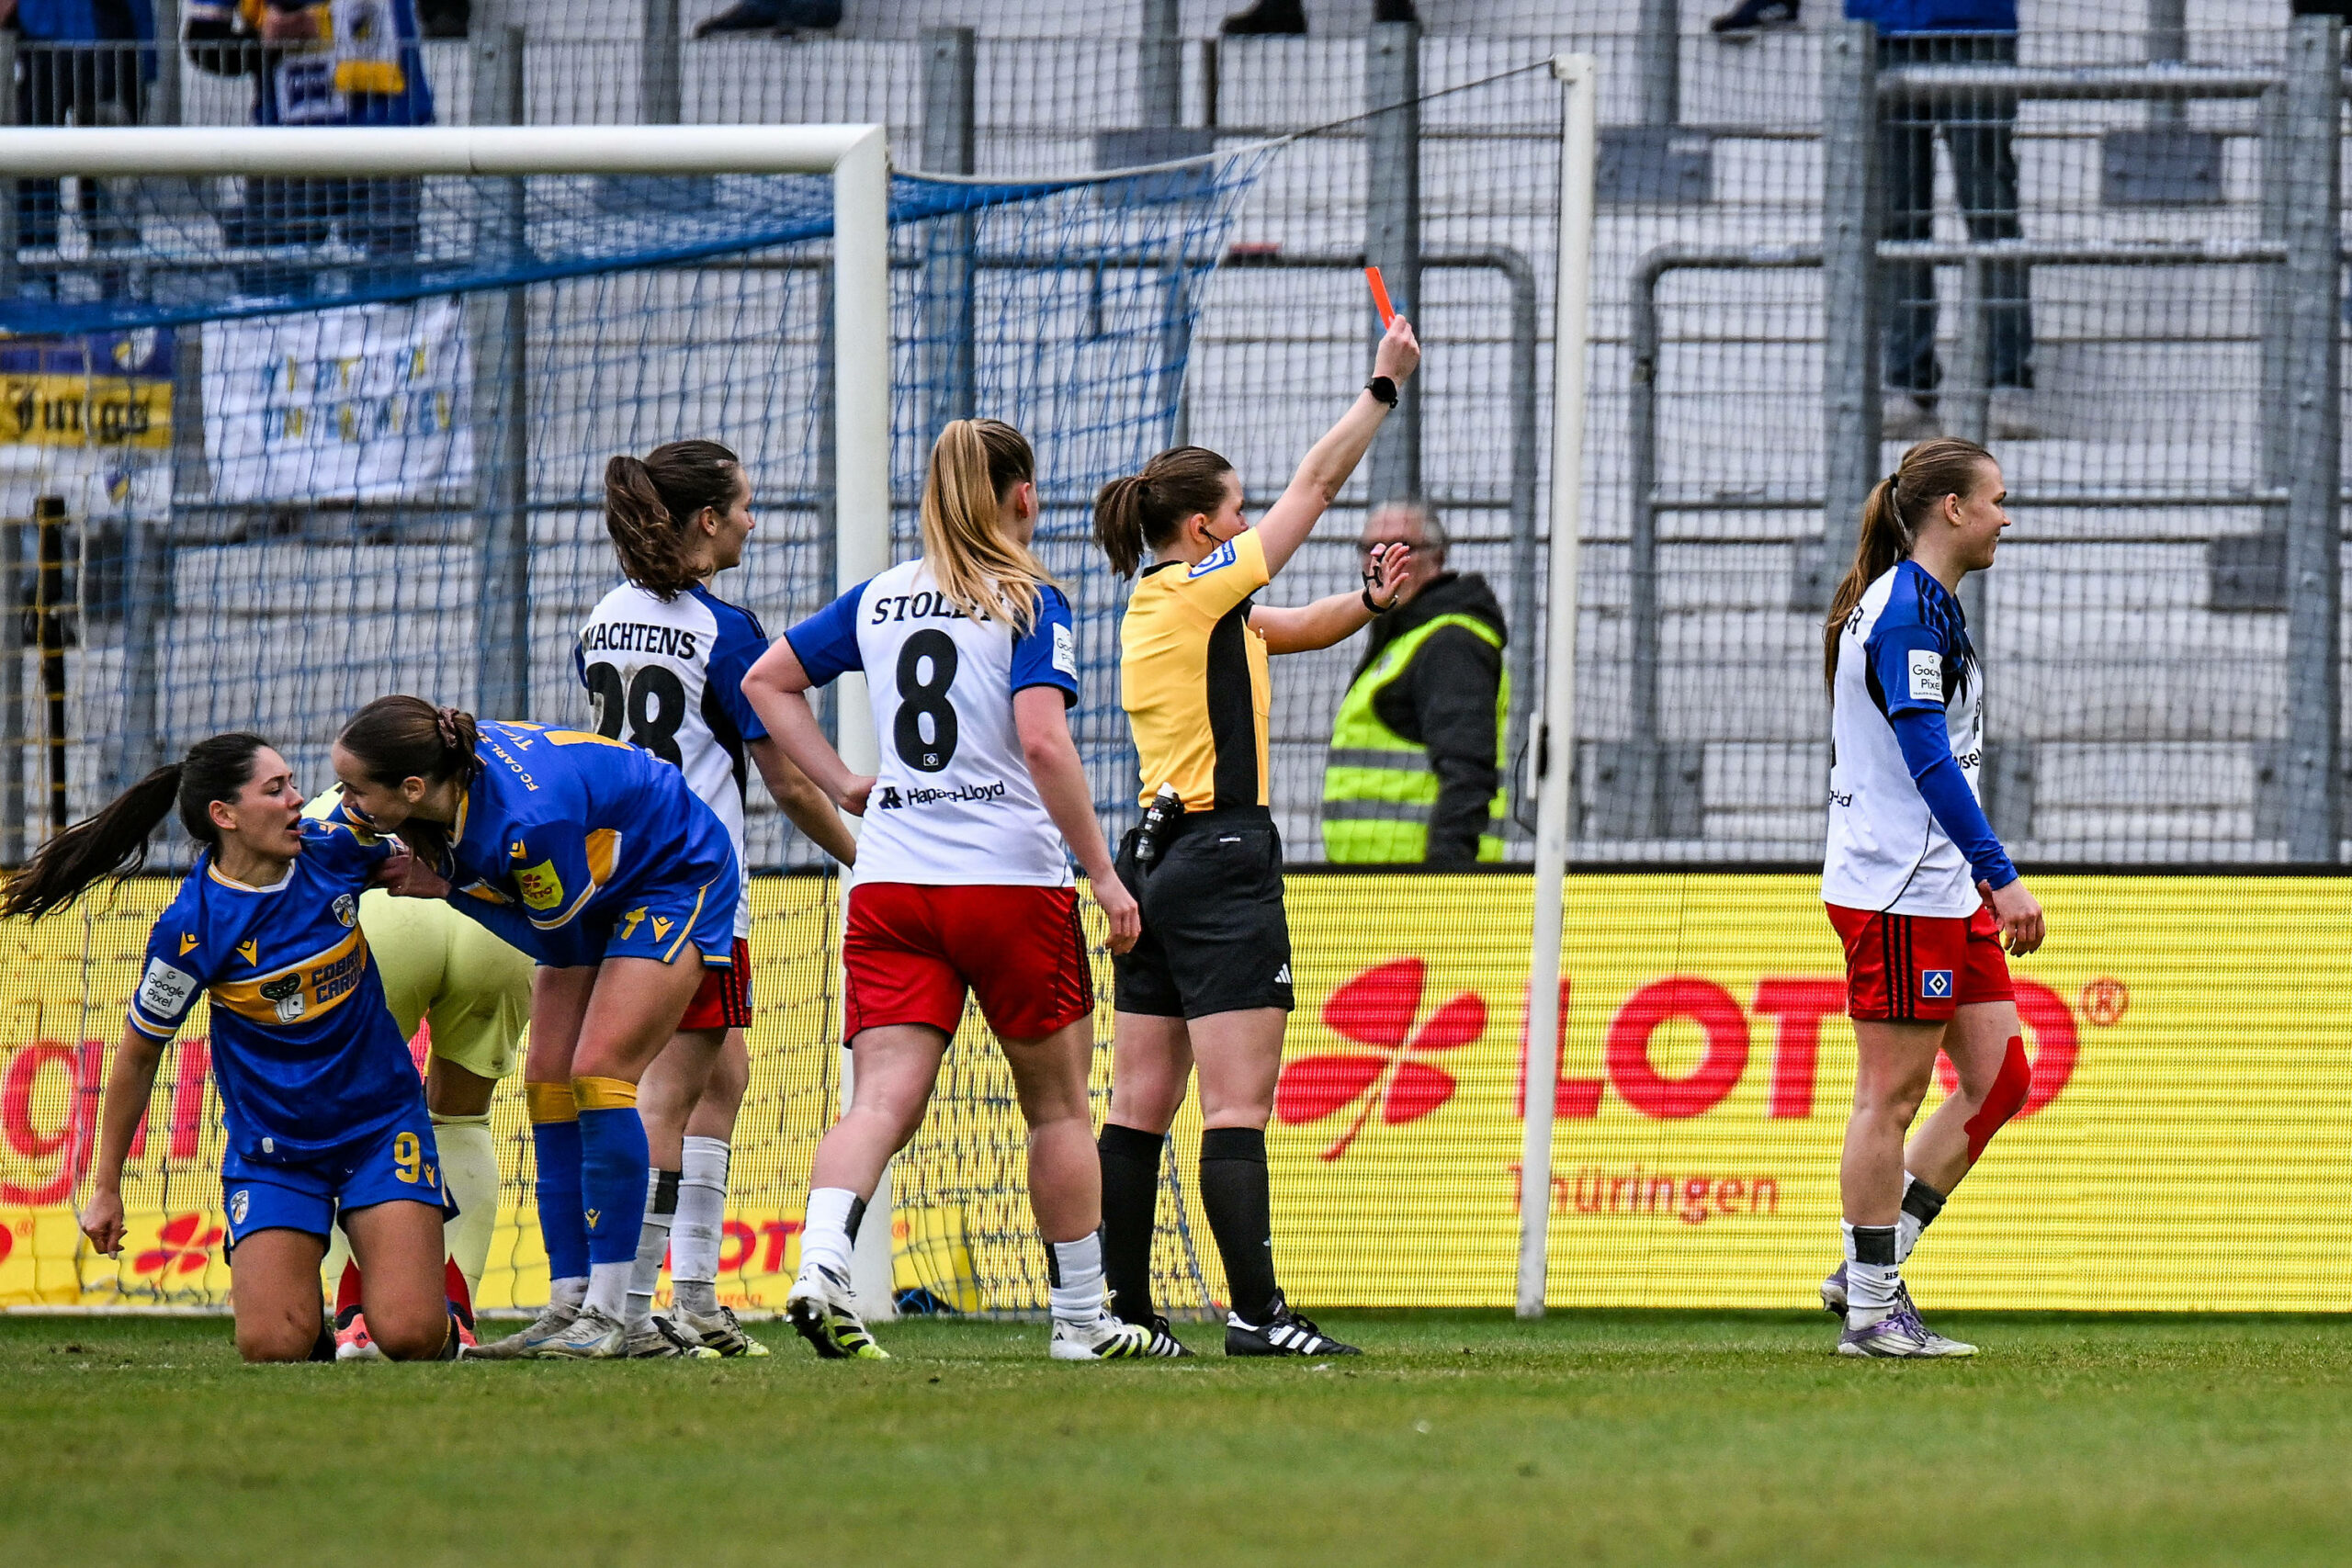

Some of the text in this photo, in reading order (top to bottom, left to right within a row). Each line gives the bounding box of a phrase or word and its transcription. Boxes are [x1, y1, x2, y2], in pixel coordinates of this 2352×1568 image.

[872, 591, 1001, 625] STOL
[1913, 664, 1940, 680] Goo
[1921, 679, 1940, 691] Pixe
[894, 628, 958, 773] 8
[520, 773, 539, 791] FC
[907, 781, 1005, 806] Hapag-Lloyd
[147, 988, 174, 1008] Pixel
[149, 972, 185, 998] Google
[316, 967, 362, 1004] CARD
[1517, 976, 2079, 1119] LOTO
[394, 1132, 420, 1183] 9
